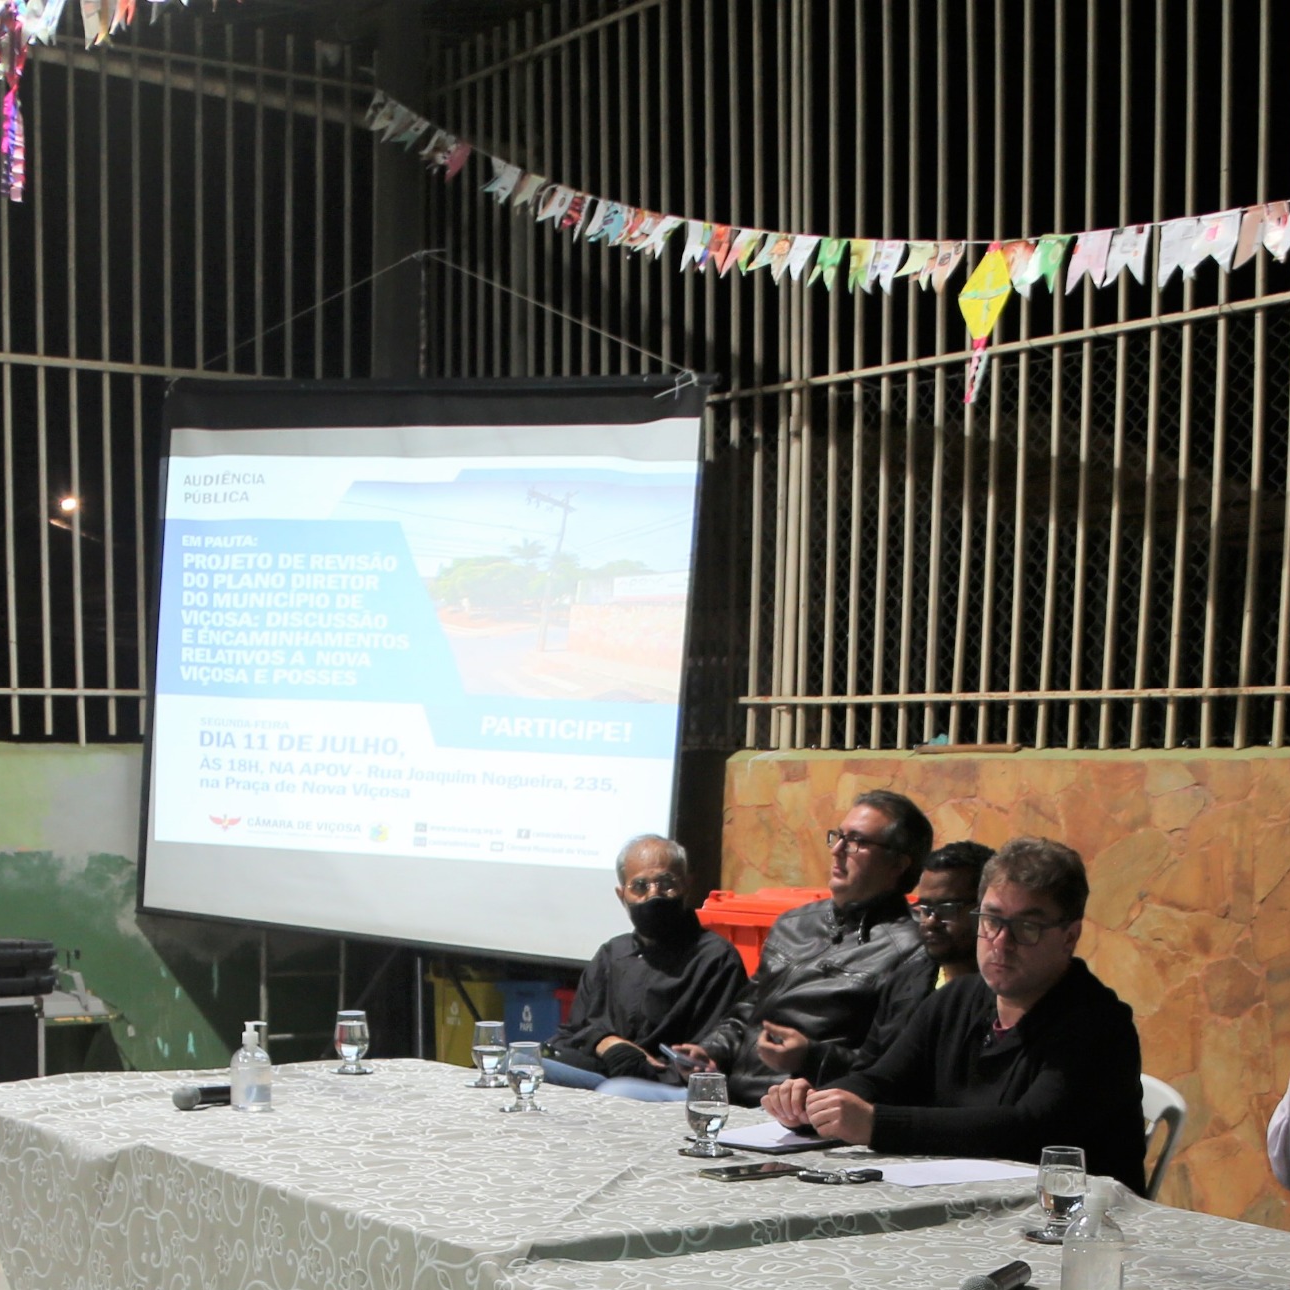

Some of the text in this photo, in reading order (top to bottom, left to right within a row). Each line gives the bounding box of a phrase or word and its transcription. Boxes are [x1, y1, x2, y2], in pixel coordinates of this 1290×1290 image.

[183, 471, 266, 487] AUDIÊNCIA
[183, 489, 250, 505] PÚBLICA
[181, 535, 258, 548] EM PAUTA:
[182, 551, 398, 572] PROJETO DE REVISÃO
[182, 572, 380, 591] DO PLANO DIRETOR
[182, 589, 364, 610] DO MUNICÍPIO DE
[181, 610, 389, 631] VIÇOSA: DISCUSSÃO
[181, 628, 410, 650] E ENCAMINHAMENTOS
[181, 647, 286, 666] RELATIVOS
[315, 651, 373, 668] NOVA
[179, 665, 358, 686] VIÇOSA E POSSES
[199, 717, 290, 729] SEGUNDA-FEIRA
[479, 715, 633, 744] PARTICIPE!
[199, 730, 407, 760] DIA 11 DE JULHO,
[228, 758, 264, 775] 18H,
[269, 761, 294, 775] NA
[299, 762, 352, 778] APOV
[367, 764, 403, 781] Rua
[407, 766, 476, 787] Joaquim
[481, 770, 568, 792] Nogueira,
[573, 776, 618, 794] 235,
[199, 776, 411, 800] na Praça de Nova Viçosa
[247, 815, 362, 834] CÂMARA DE VIÇOSA
